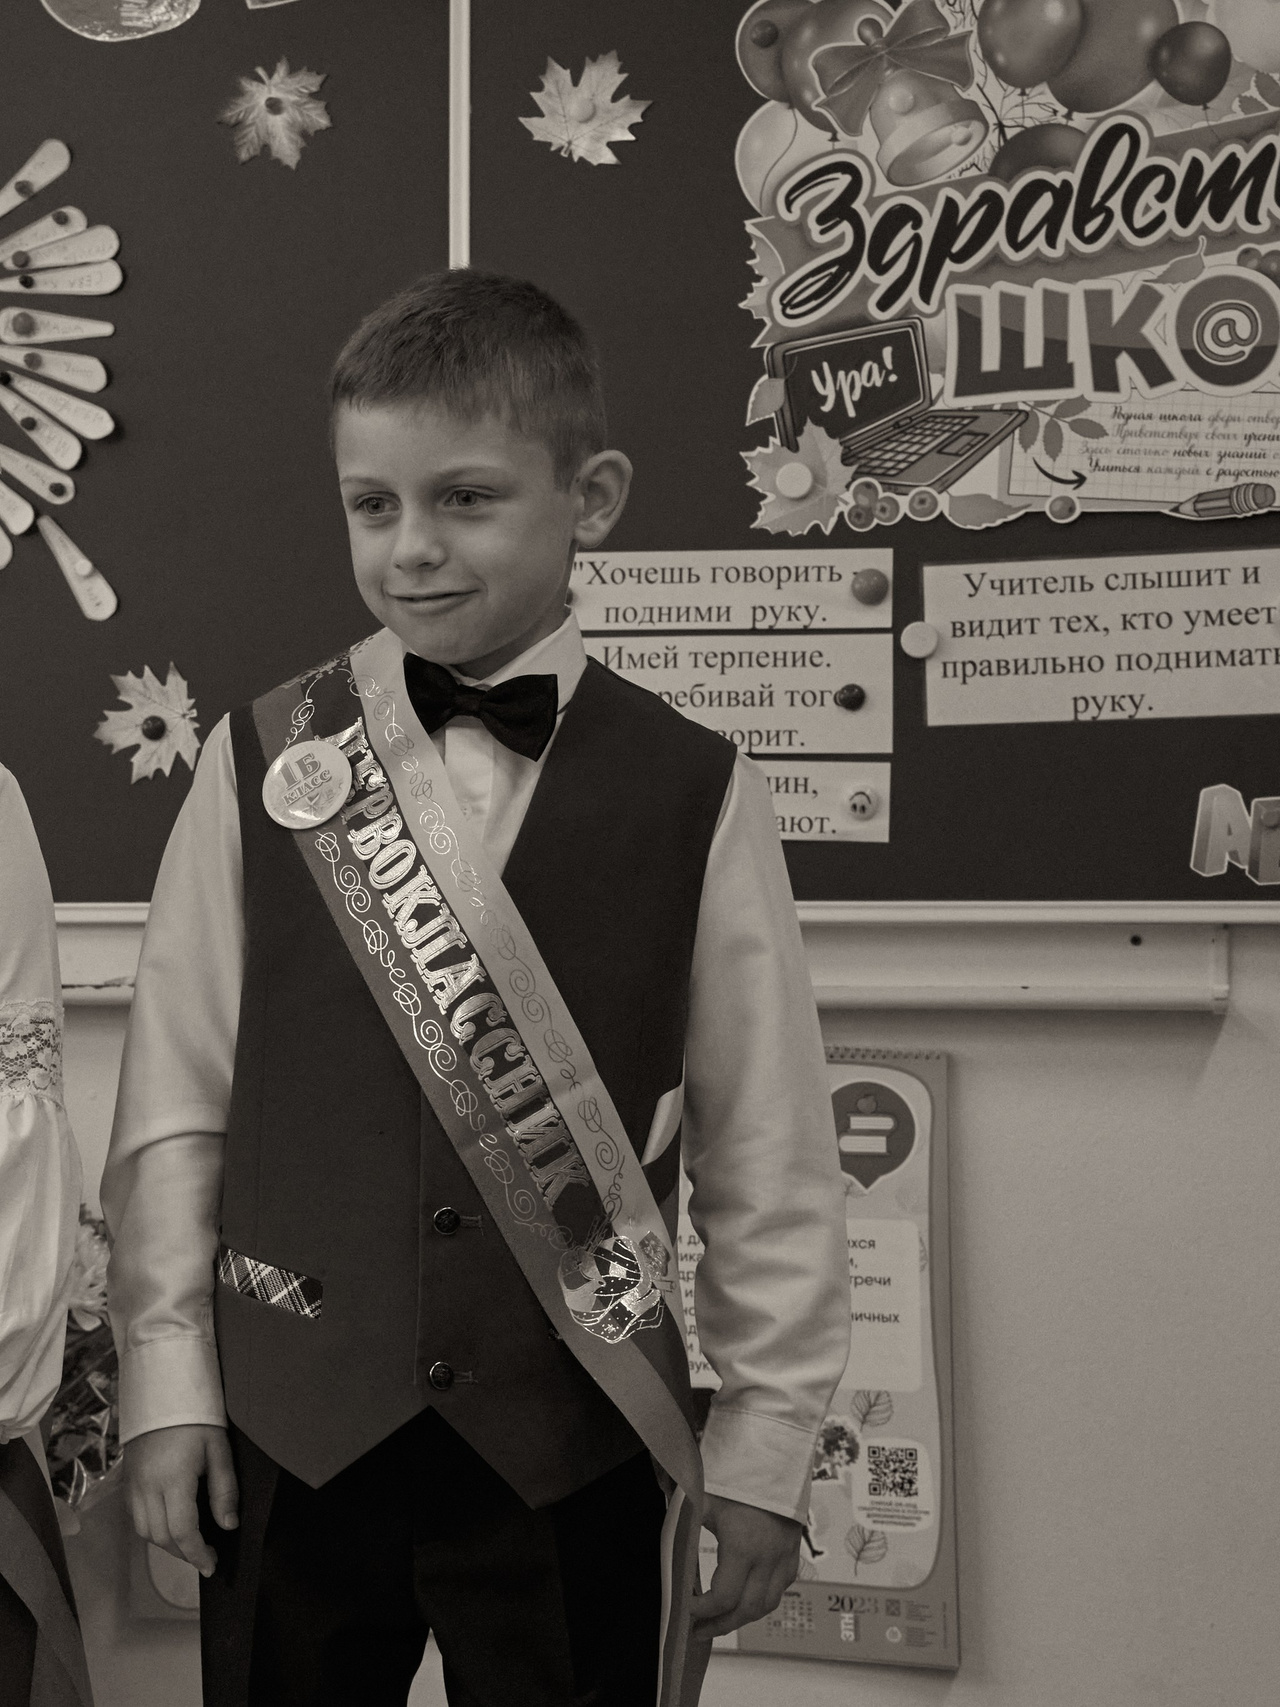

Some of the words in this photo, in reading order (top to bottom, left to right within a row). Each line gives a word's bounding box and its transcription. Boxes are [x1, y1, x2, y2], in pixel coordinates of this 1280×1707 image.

[779, 122, 1280, 318] Здравст
[811, 346, 899, 417] Ура!
[710, 565, 843, 590] говорить
[963, 572, 1095, 598] Учитель
[1104, 568, 1231, 591] слышит
[1242, 566, 1261, 585] и
[604, 604, 732, 626] подними
[751, 604, 827, 628] руку.
[951, 617, 1041, 639] видит
[1050, 613, 1110, 636] тех,
[1121, 611, 1173, 631] кто
[1183, 606, 1277, 635] умеет
[603, 645, 678, 670] Имей
[689, 649, 831, 675] терпение.
[941, 654, 1105, 685] правильно
[658, 683, 774, 708] ребивай
[1072, 693, 1153, 720] руку.
[282, 769, 332, 807] КЛАСС
[774, 815, 837, 834] ают.
